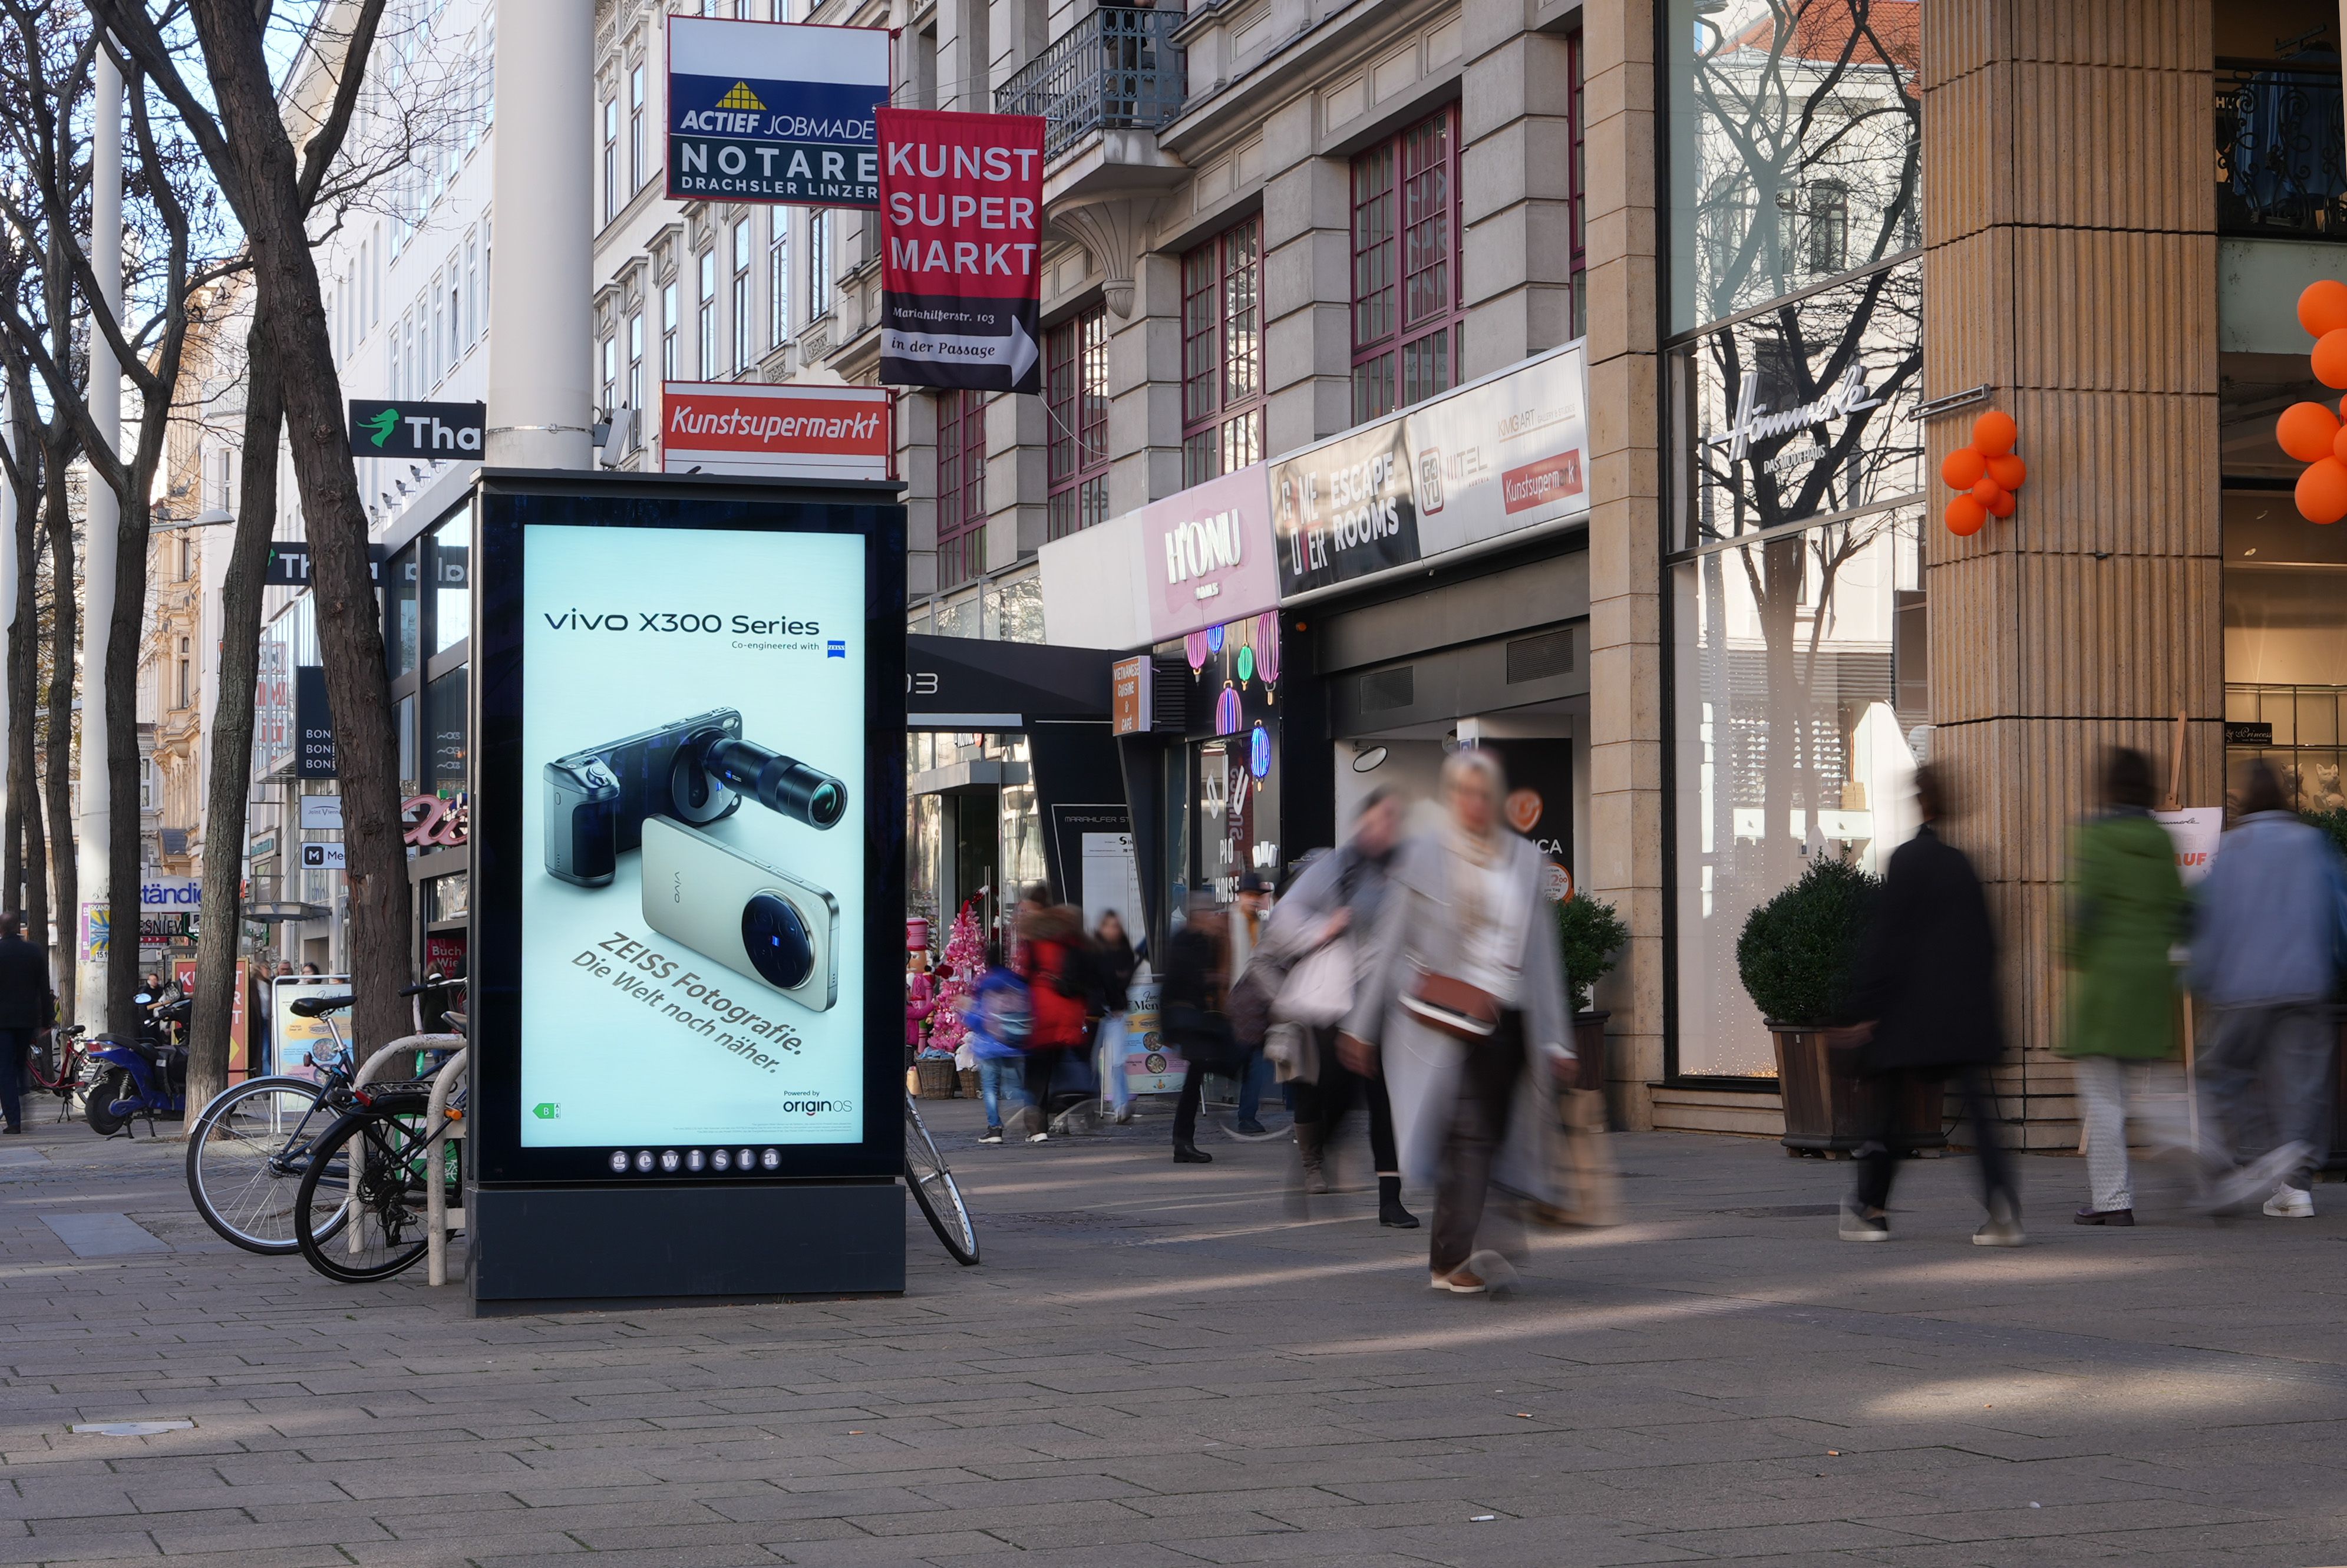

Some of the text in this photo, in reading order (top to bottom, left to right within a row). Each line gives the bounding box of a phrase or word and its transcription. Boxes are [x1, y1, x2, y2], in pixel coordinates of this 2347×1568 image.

[680, 110, 876, 140] ACTIEF JOBMADE
[681, 143, 879, 183] NOTARE
[888, 141, 1038, 181] KUNST
[681, 176, 879, 199] DRACHSLER LINZER
[889, 192, 1035, 229] SUPER
[891, 236, 1037, 276] MARKT
[893, 306, 995, 324] Mariahilferstr. 103
[892, 336, 995, 358] in der Passage
[404, 416, 481, 450] Tha
[670, 405, 880, 443] Kunstsupermarkt
[1330, 451, 1395, 510] ESCAPE
[1332, 496, 1399, 552] ROOMS
[543, 607, 820, 636] vivo X300 Series
[731, 641, 797, 651] Co-engineered
[800, 642, 820, 651] with
[141, 883, 203, 908] tändi
[1215, 876, 1240, 903] HOUSE
[432, 945, 462, 956] Buch
[598, 931, 802, 1055] ZEISS Fotografie.
[572, 950, 780, 1073] Die Welt noch näher.
[612, 1149, 779, 1170] gewista
